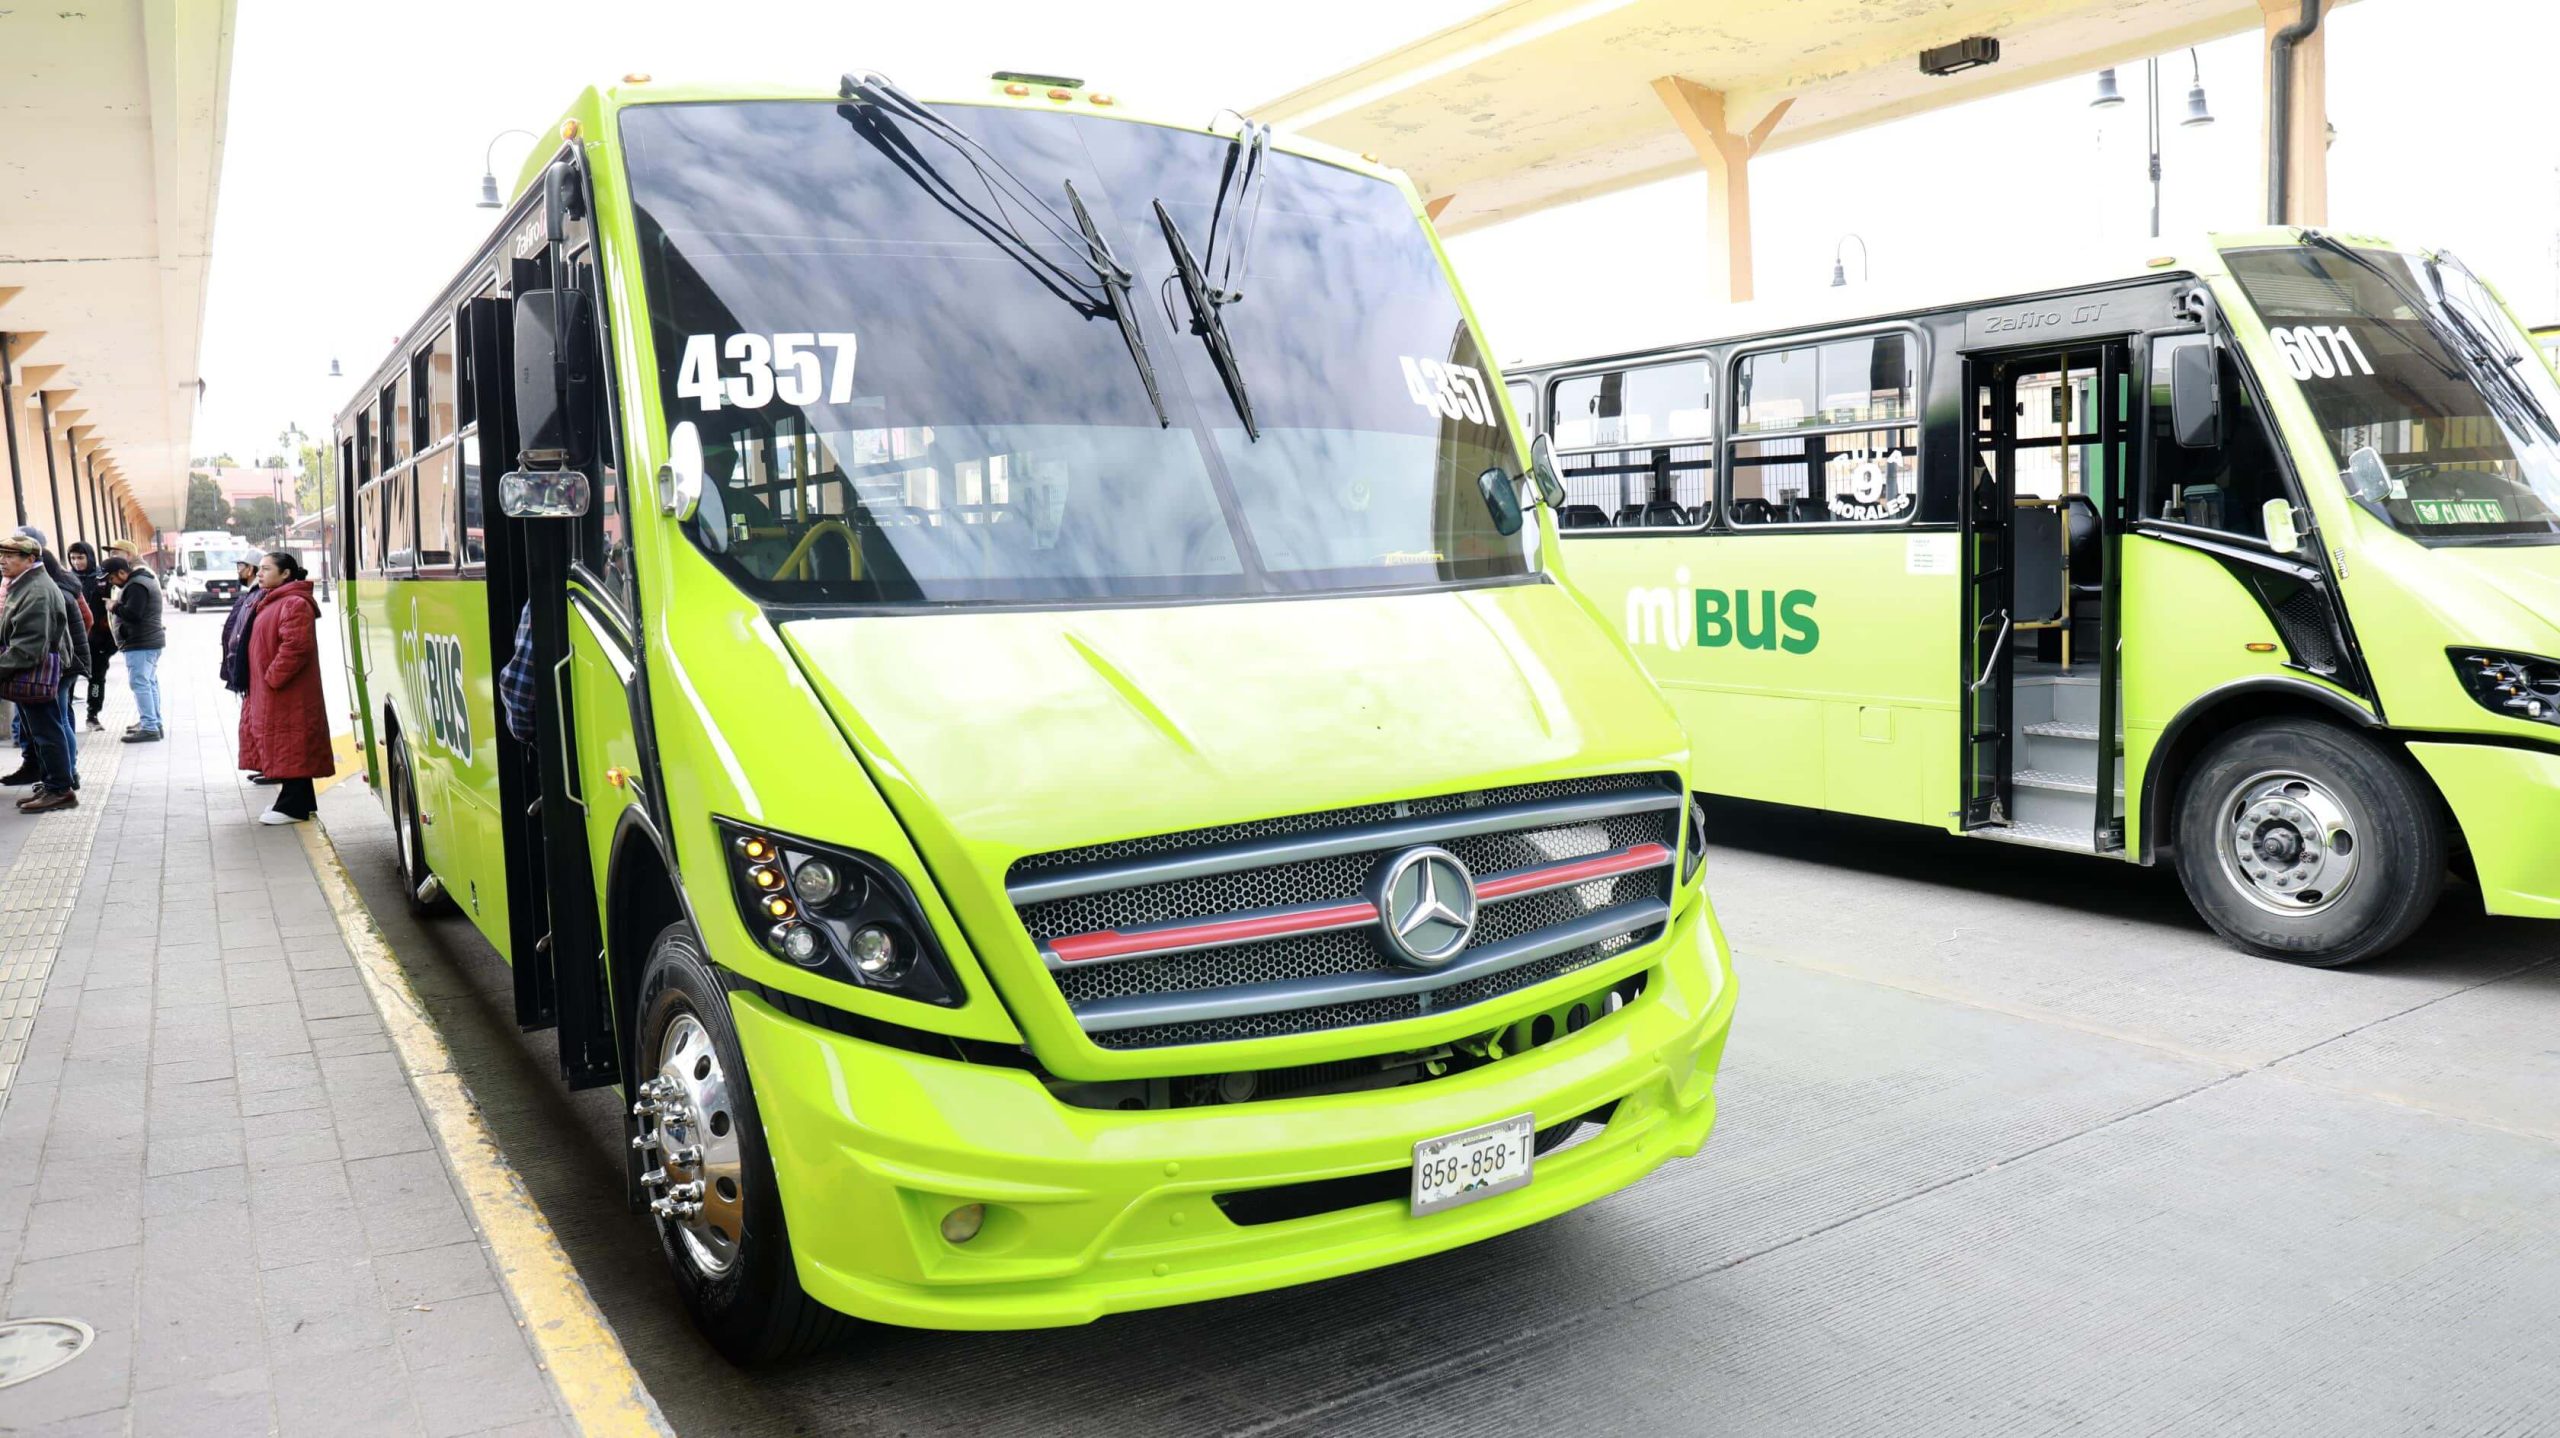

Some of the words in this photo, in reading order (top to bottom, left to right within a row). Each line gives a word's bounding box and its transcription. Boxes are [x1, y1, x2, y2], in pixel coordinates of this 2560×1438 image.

[2071, 303, 2109, 324] GT
[677, 332, 857, 411] 4357
[2270, 326, 2375, 381] 6071
[1399, 356, 1496, 427] 4357
[1828, 494, 1910, 520] MORALES
[1853, 462, 1884, 503] 9
[1422, 1134, 1529, 1191] 858-858-T
